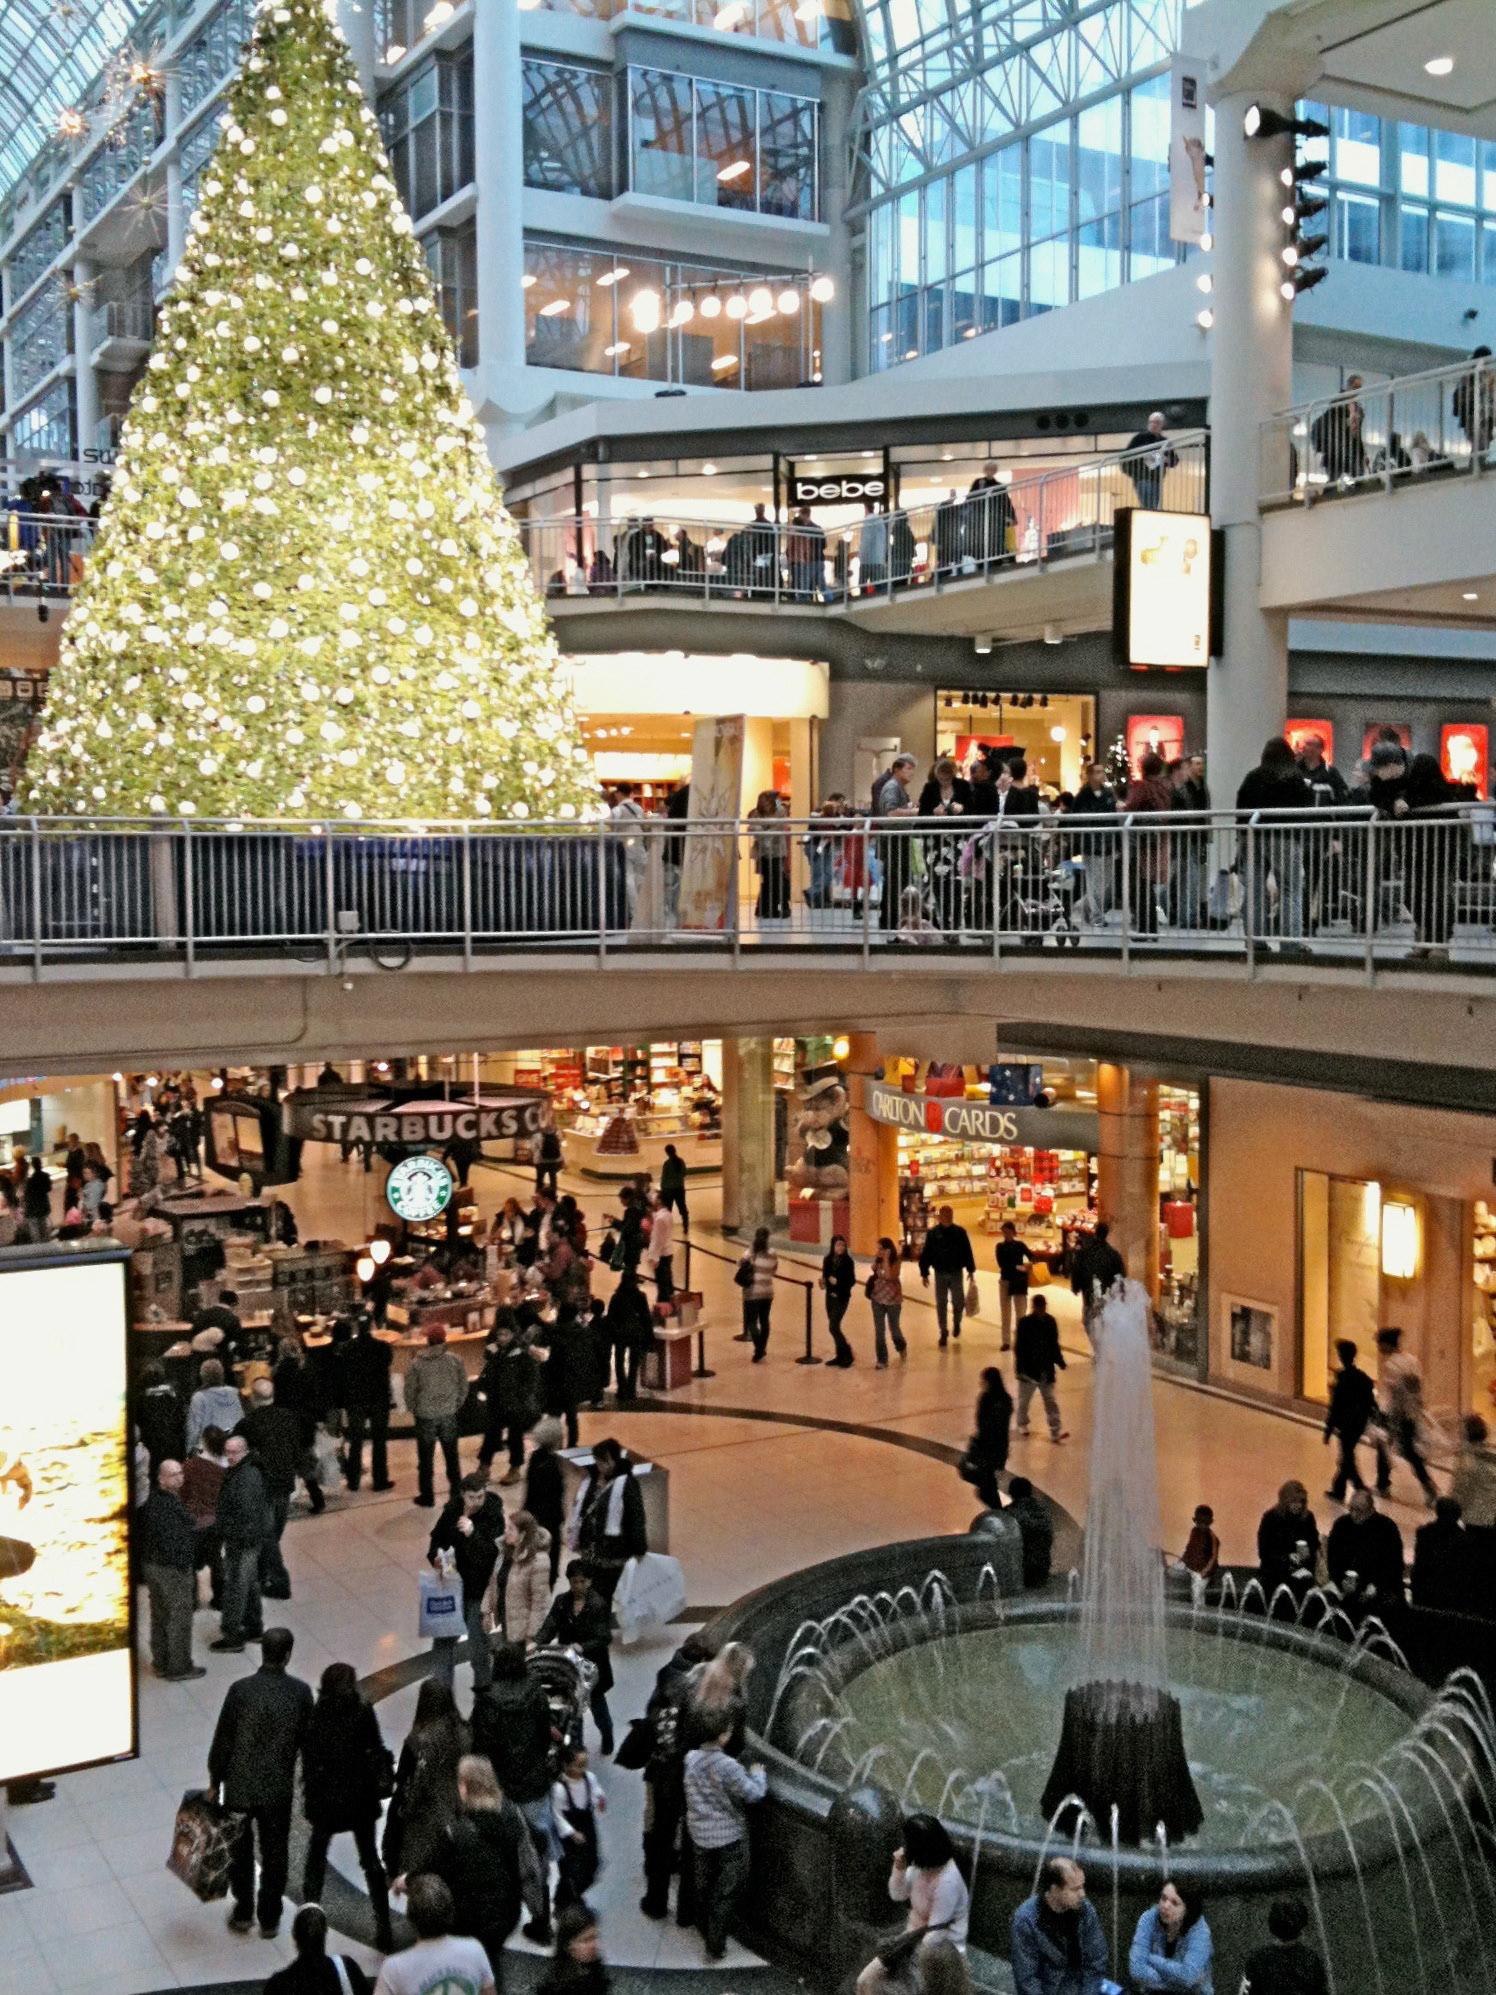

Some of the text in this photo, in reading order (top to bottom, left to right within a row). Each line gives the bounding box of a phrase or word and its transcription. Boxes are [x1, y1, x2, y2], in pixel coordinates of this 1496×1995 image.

[796, 480, 885, 500] bebe
[311, 1109, 518, 1142] STARBUCKS
[872, 1090, 1018, 1140] CARLTON CARDS
